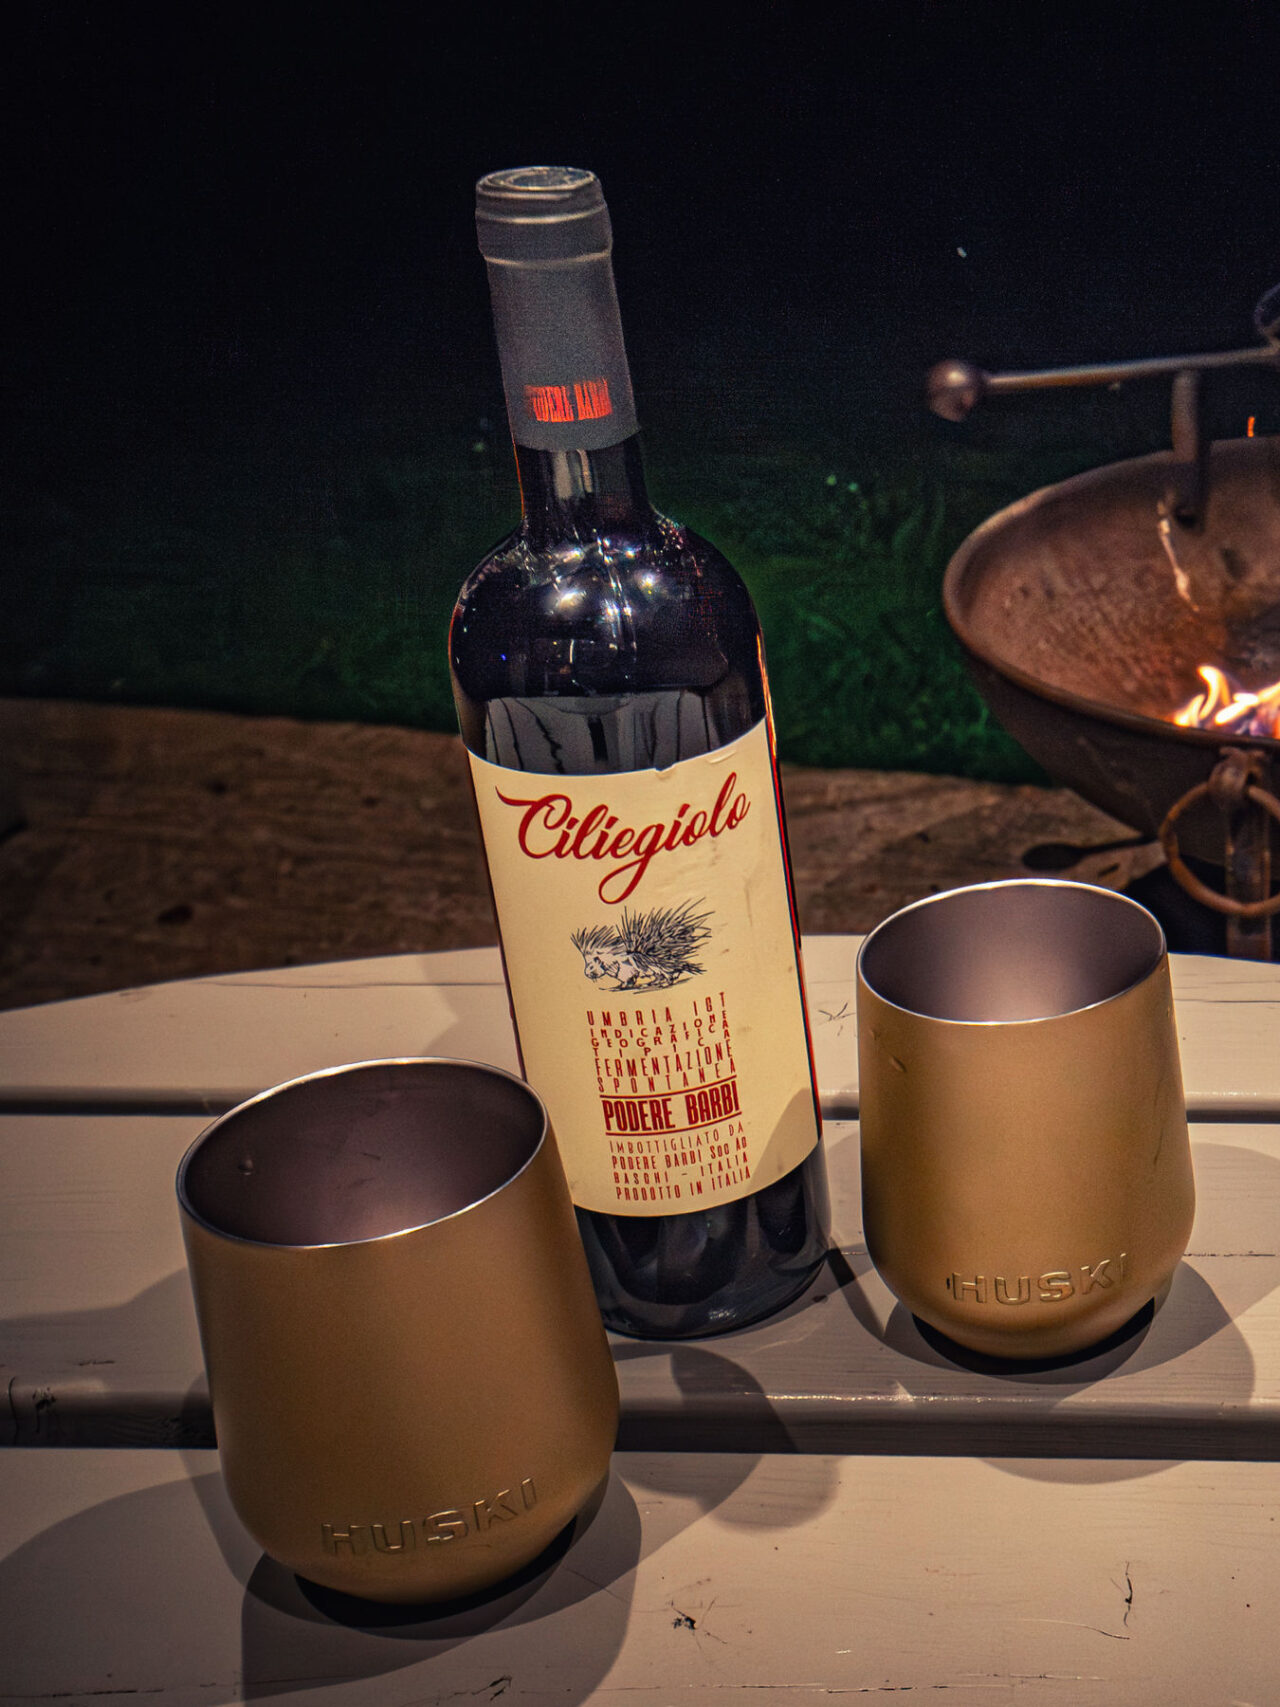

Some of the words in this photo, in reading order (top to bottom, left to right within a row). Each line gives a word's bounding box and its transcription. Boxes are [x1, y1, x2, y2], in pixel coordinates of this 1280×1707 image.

[495, 772, 751, 905] Ciliegiolo
[586, 1006, 673, 1027] UMBRIA
[589, 1010, 728, 1039] INDICAZIONE
[591, 1019, 730, 1049] GEOGRAFICA
[594, 1039, 733, 1078] FERMENTAZIONE
[597, 1057, 737, 1094] SPONTANEA
[601, 1098, 676, 1132] PODERE
[684, 1080, 741, 1126] BARBI
[609, 1128, 720, 1155] IMBOTTIGLIATO
[728, 1120, 744, 1137] DA
[611, 1155, 657, 1170] PODERE
[664, 1149, 703, 1169] BARBI
[699, 1151, 749, 1177] ITALIA
[616, 1184, 681, 1201] PRODOTTO
[689, 1180, 704, 1197] IN
[711, 1165, 751, 1191] ITALIA
[951, 1252, 1129, 1306] HUSKI
[321, 1477, 537, 1556] HUSKI
